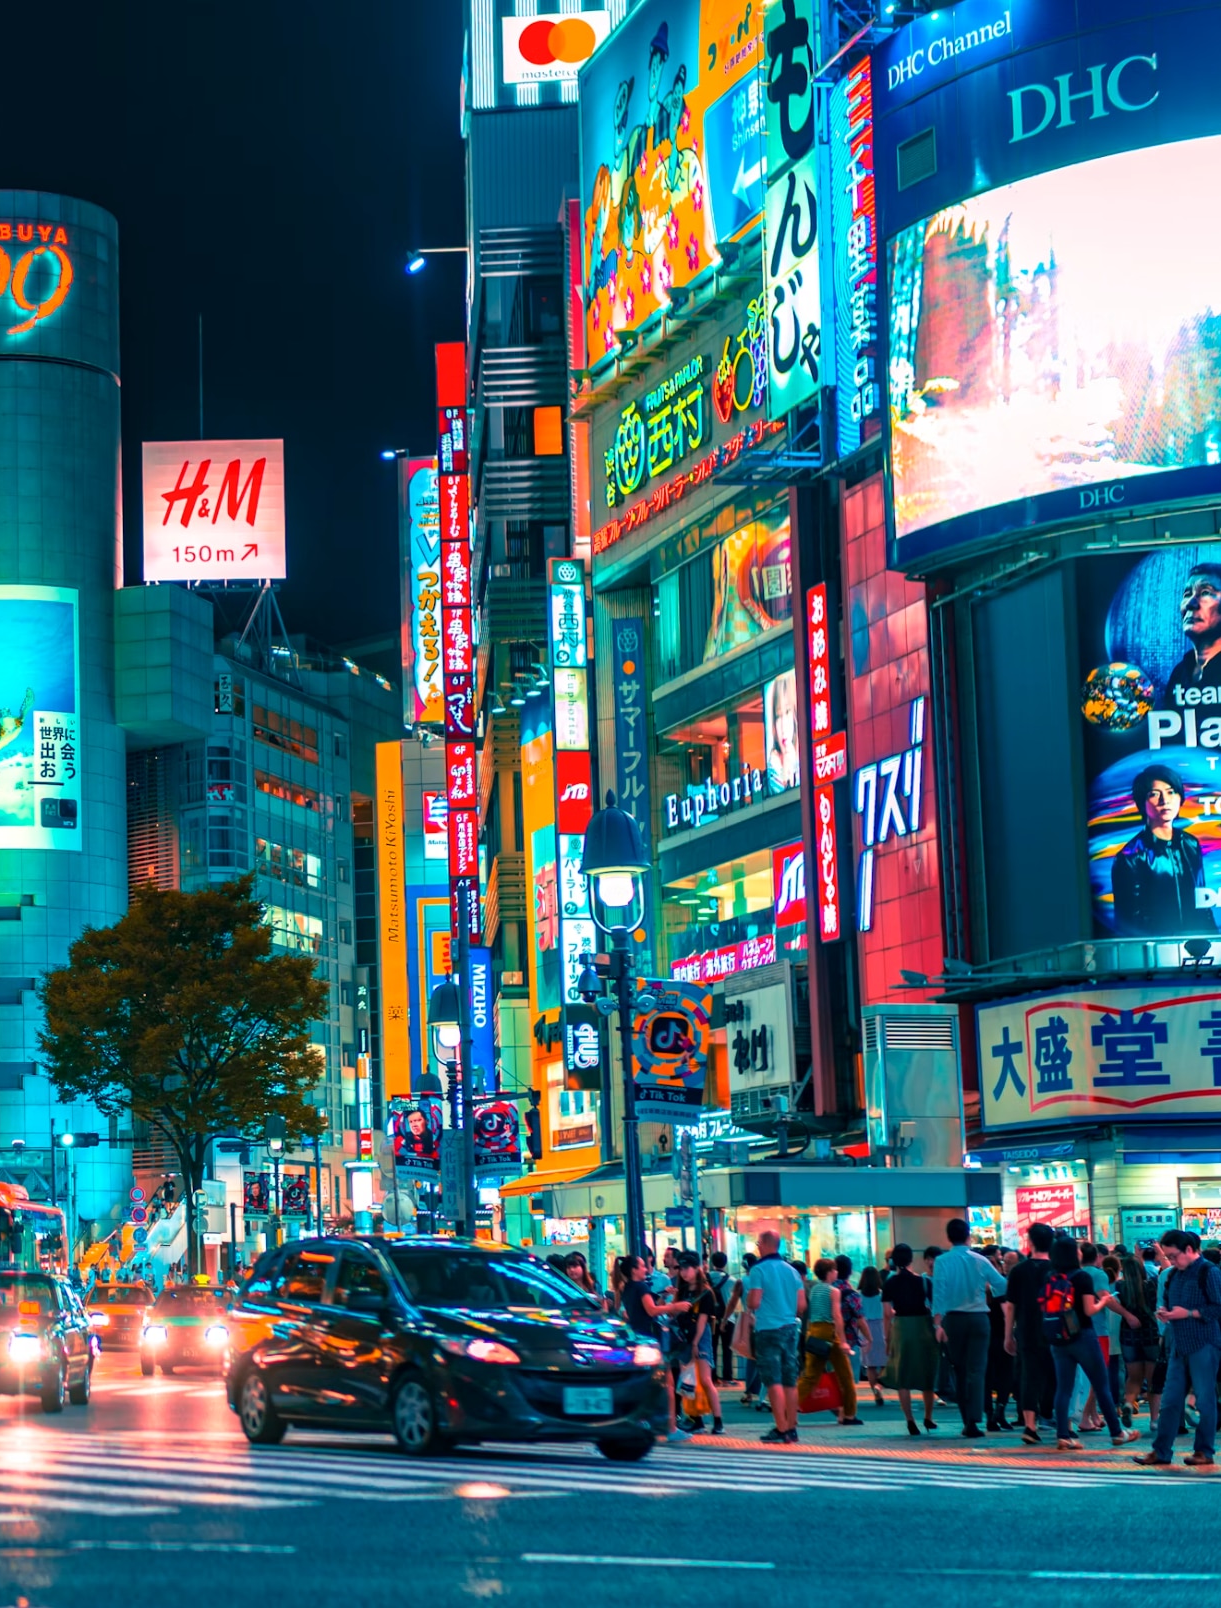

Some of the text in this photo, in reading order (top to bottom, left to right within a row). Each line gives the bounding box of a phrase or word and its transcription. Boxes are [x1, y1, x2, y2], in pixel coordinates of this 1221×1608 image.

[887, 10, 1013, 92] DHC Channel
[1006, 52, 1160, 145] DHC
[765, 0, 821, 384] もんじゃ
[646, 381, 704, 479] 西村
[160, 457, 267, 528] H&M
[1079, 484, 1125, 509] DHC
[450, 542, 461, 551] 7F
[451, 609, 463, 618] 7F
[811, 594, 829, 731] お好み焼
[452, 675, 466, 685] 6F
[39, 726, 76, 742] 世界に
[454, 745, 467, 755] 6F
[560, 783, 589, 801] JTB
[665, 766, 763, 829] Euphoria
[455, 813, 469, 823] 6F
[384, 789, 400, 943] Matsumoto KiYoshi
[564, 858, 576, 899] パーラー
[567, 943, 580, 985] フルーツ
[705, 954, 736, 978] 海外旅行
[472, 963, 487, 1028] MIZUHO
[574, 1022, 599, 1069] HUB
[648, 1088, 687, 1103] Tik Tok
[412, 1158, 423, 1168] Tik
[486, 1155, 512, 1164] Tik Tok
[1002, 1149, 1039, 1160] TAISEIDO
